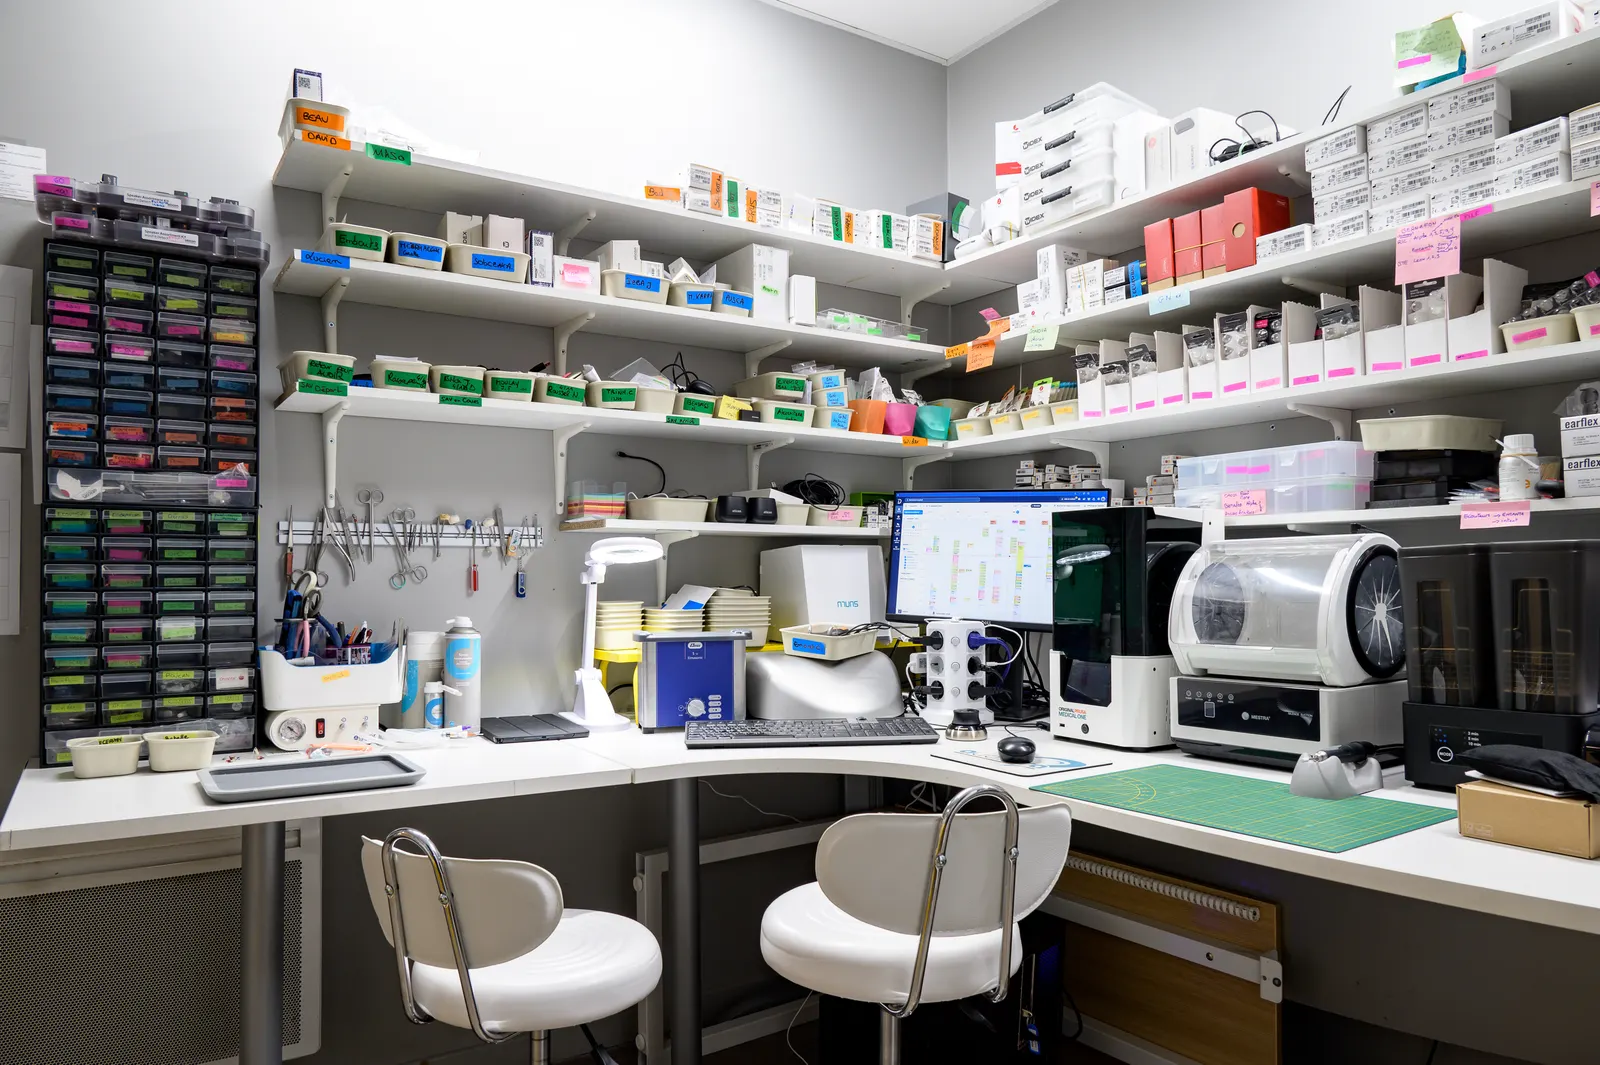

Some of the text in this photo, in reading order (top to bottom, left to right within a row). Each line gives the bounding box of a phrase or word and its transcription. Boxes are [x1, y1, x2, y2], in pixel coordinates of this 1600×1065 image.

[1565, 417, 1598, 429] earflex
[1567, 458, 1600, 469] earflex
[1058, 711, 1077, 719] MEDICAL
